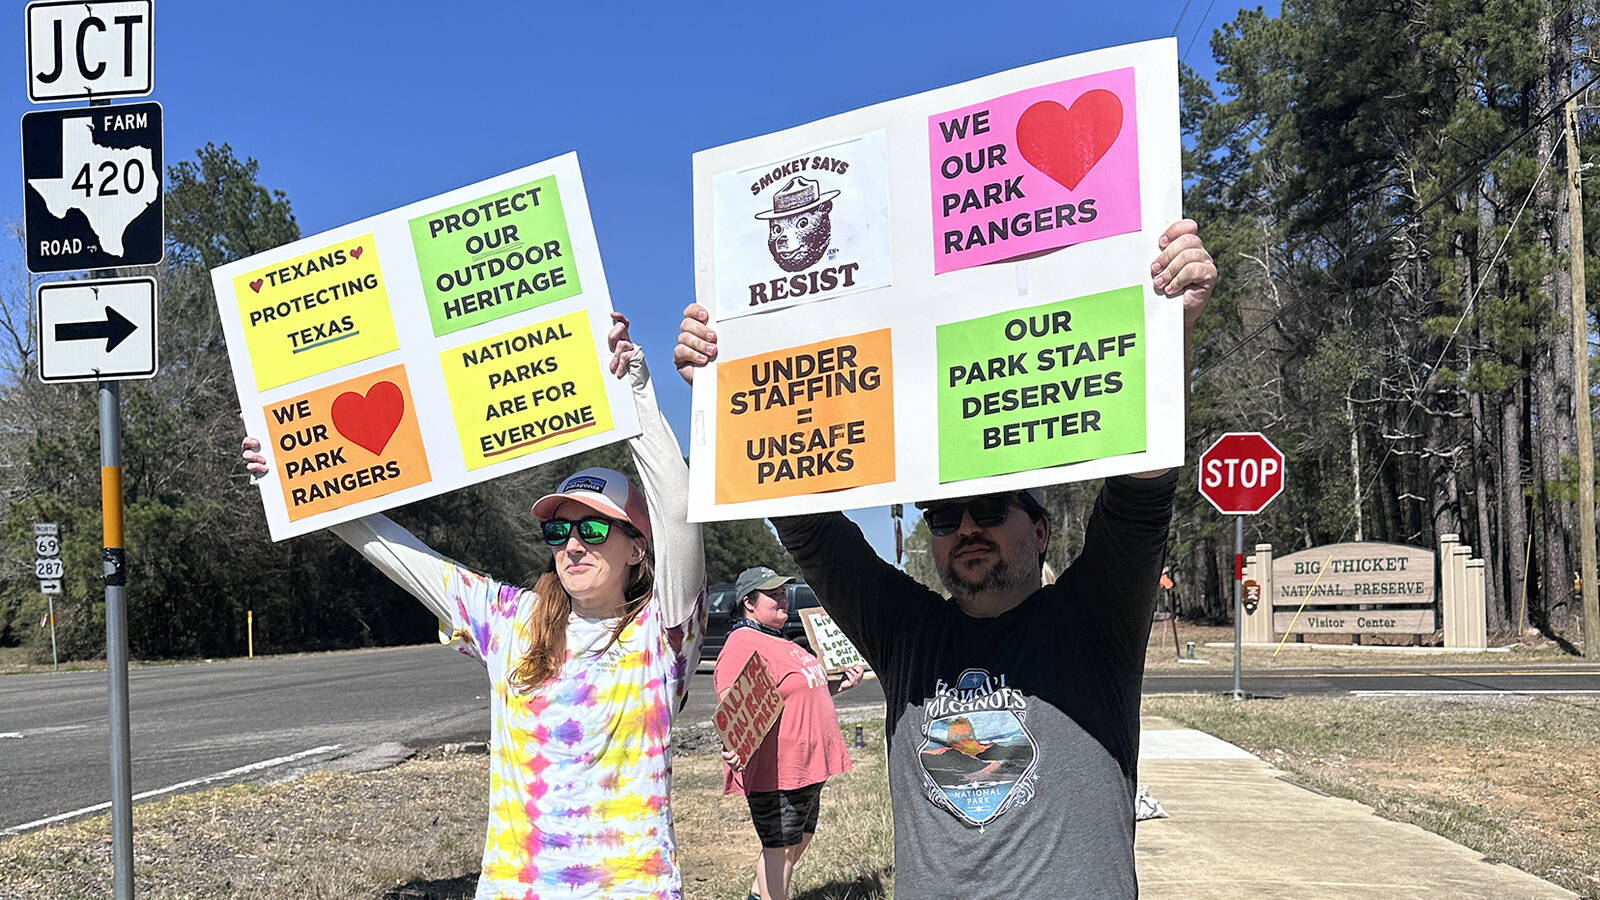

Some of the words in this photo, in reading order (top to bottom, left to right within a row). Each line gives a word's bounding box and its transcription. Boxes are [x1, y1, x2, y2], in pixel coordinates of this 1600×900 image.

[36, 15, 143, 84] JCT
[103, 113, 148, 131] FARM
[939, 109, 990, 143] WE
[71, 158, 145, 198] 420
[750, 157, 810, 196] SMOKEY
[811, 155, 849, 175] SAYS
[941, 143, 1007, 179] OUR
[428, 186, 541, 239] PROTECT
[942, 175, 1025, 217] PARK
[466, 224, 520, 254] OUR
[944, 199, 1098, 254] RANGERS
[40, 238, 82, 256] ROAD
[436, 240, 562, 292] OUTDOOR
[265, 250, 347, 287] TEXANS
[748, 262, 859, 307] RESIST
[249, 273, 378, 327] PROTECTING
[443, 266, 567, 320] HERITAGE
[287, 315, 354, 348] TEXAS
[462, 323, 572, 367] NATIONAL
[1005, 310, 1072, 341] OUR
[488, 356, 558, 389] PARKS
[751, 344, 858, 387] UNDER
[949, 352, 1029, 388] PARK
[1036, 333, 1137, 371] STAFF
[485, 395, 528, 421] ARE
[532, 381, 577, 407] FOR
[730, 366, 881, 415] STAFFING
[962, 371, 1123, 419] DESERVES
[272, 400, 312, 425] WE
[480, 405, 594, 452] EVERYONE
[983, 410, 1102, 450] BETTER
[280, 424, 329, 451] OUR
[746, 420, 865, 461] UNSAFE
[286, 446, 347, 479] PARK
[757, 448, 854, 484] PARKS
[1205, 458, 1278, 488] STOP
[291, 460, 401, 506] RANGERS
[38, 540, 56, 552] 69
[1294, 561, 1321, 575] BIG
[1331, 557, 1408, 573] THICKET
[37, 562, 61, 575] 287
[1281, 584, 1343, 597] NATIONAL
[1354, 582, 1424, 595] PRESERVE
[1308, 617, 1345, 628] Visitor
[1357, 617, 1396, 628] Center
[717, 680, 744, 731] ONLY
[743, 652, 762, 686] YOU
[753, 686, 780, 737] PARKS
[728, 710, 748, 748] CAN
[954, 788, 1001, 798] NATIONAL
